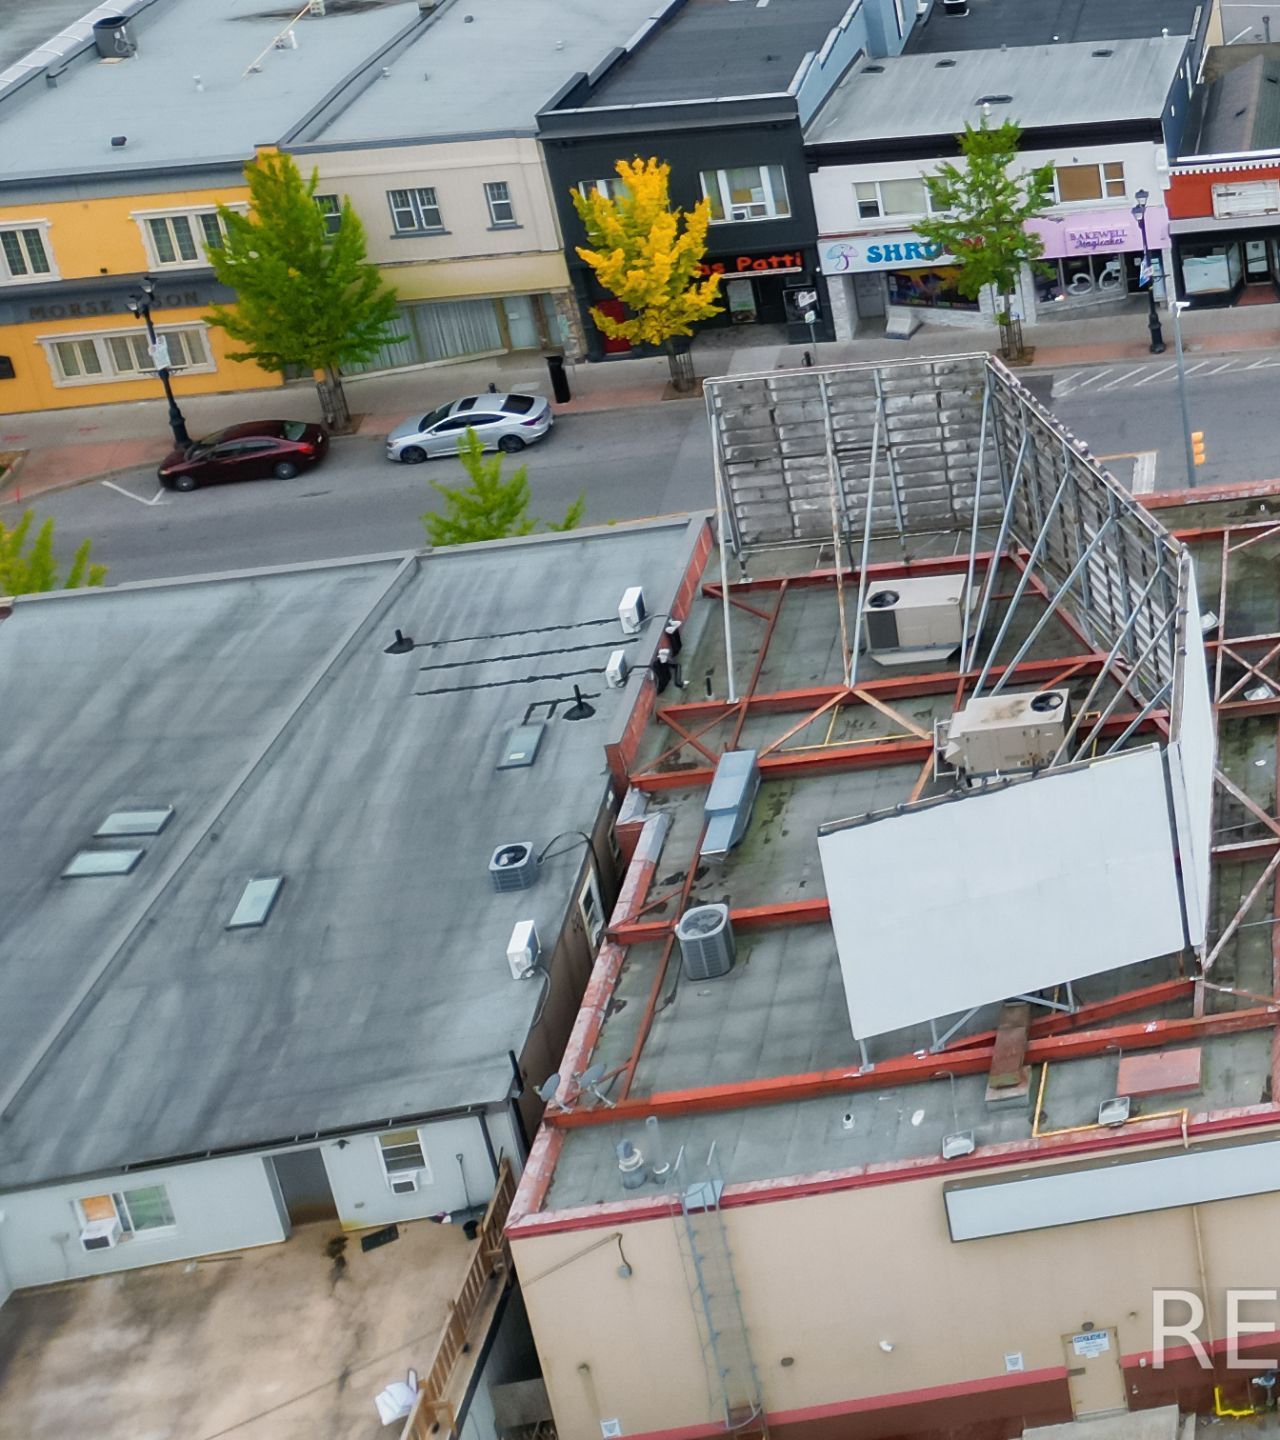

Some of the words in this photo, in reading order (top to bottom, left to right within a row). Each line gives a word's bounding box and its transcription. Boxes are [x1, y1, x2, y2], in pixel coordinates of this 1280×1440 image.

[1069, 229, 1127, 240] BAKEWELL
[30, 300, 112, 320] MORSE
[156, 291, 199, 308] SON
